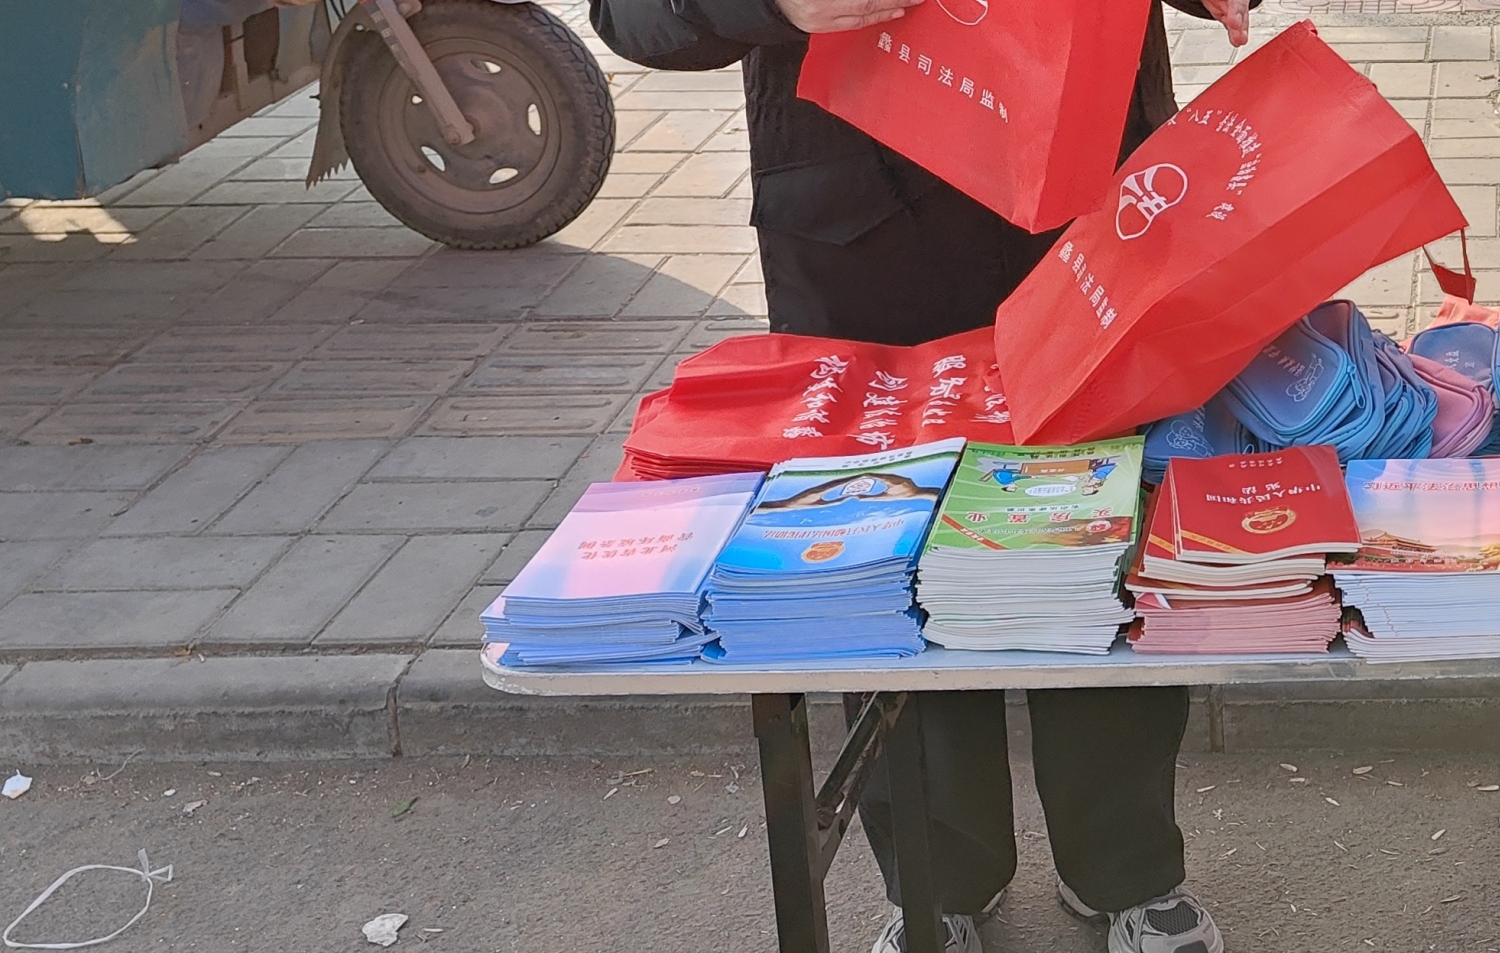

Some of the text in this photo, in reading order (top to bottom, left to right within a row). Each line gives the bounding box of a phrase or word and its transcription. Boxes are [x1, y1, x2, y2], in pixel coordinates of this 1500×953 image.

[1205, 483, 1321, 505] 中华人民共和国
[1241, 480, 1281, 495] 宪法
[1363, 481, 1500, 492] 习近平法治思想
[965, 507, 1113, 525] 买房置业
